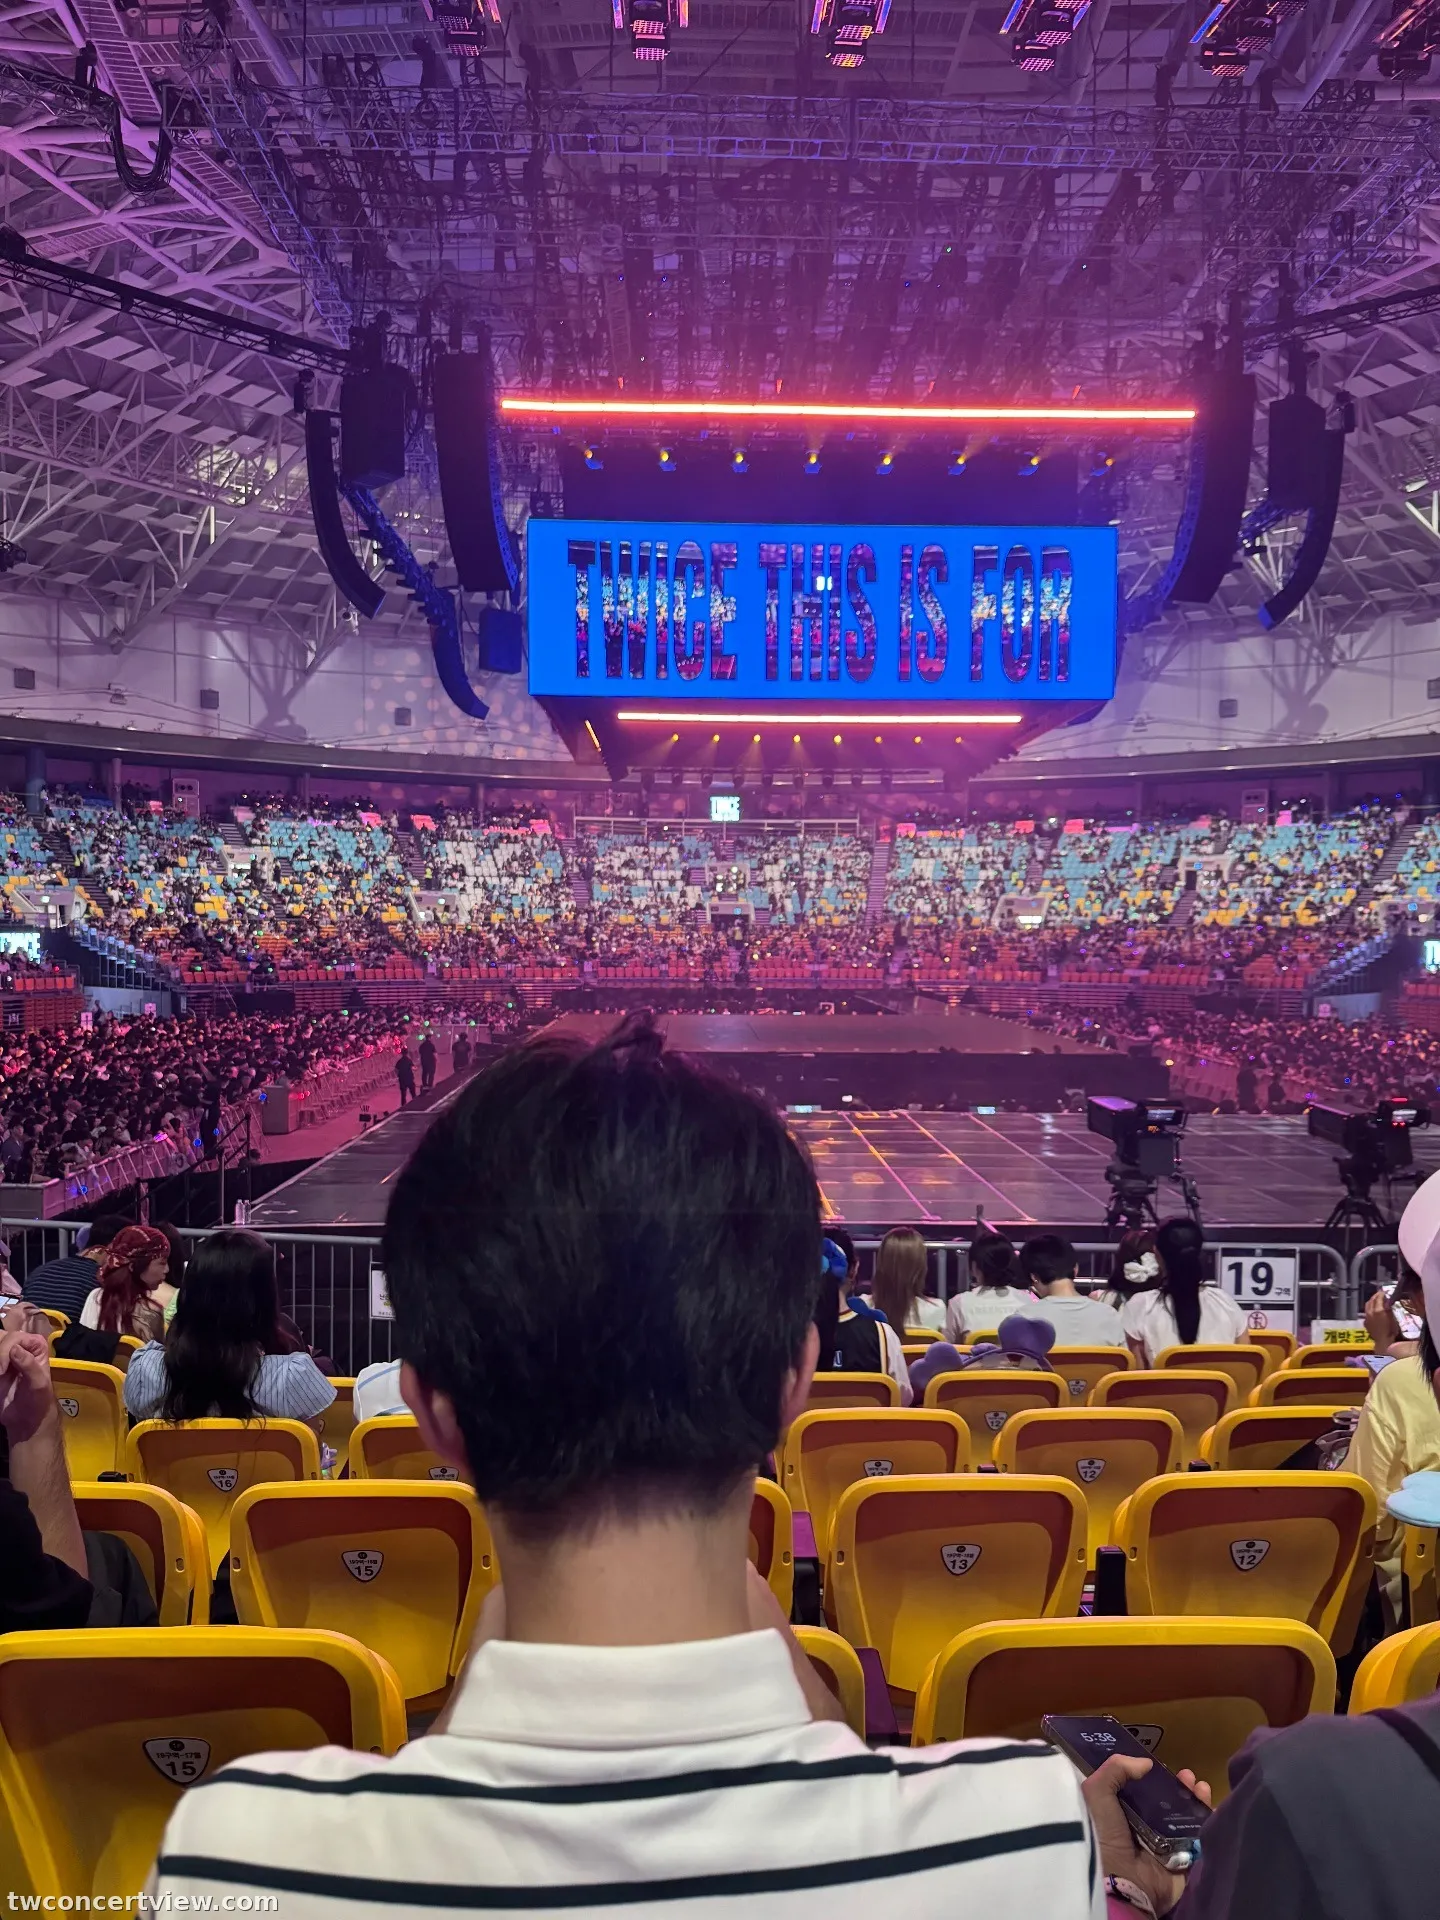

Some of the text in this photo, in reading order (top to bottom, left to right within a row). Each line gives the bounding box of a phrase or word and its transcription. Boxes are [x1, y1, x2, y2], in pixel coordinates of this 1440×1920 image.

[568, 540, 1072, 682] TWICE THIS IS FOR
[1227, 1261, 1291, 1297] 19 구역
[1324, 1330, 1350, 1344] 개방
[1082, 1470, 1097, 1478] 12
[217, 1479, 232, 1488] 16
[950, 1559, 969, 1570] 13
[1238, 1554, 1257, 1565] 12
[354, 1565, 374, 1577] 15
[1080, 1732, 1117, 1743] 5:38
[165, 1761, 197, 1776] 15
